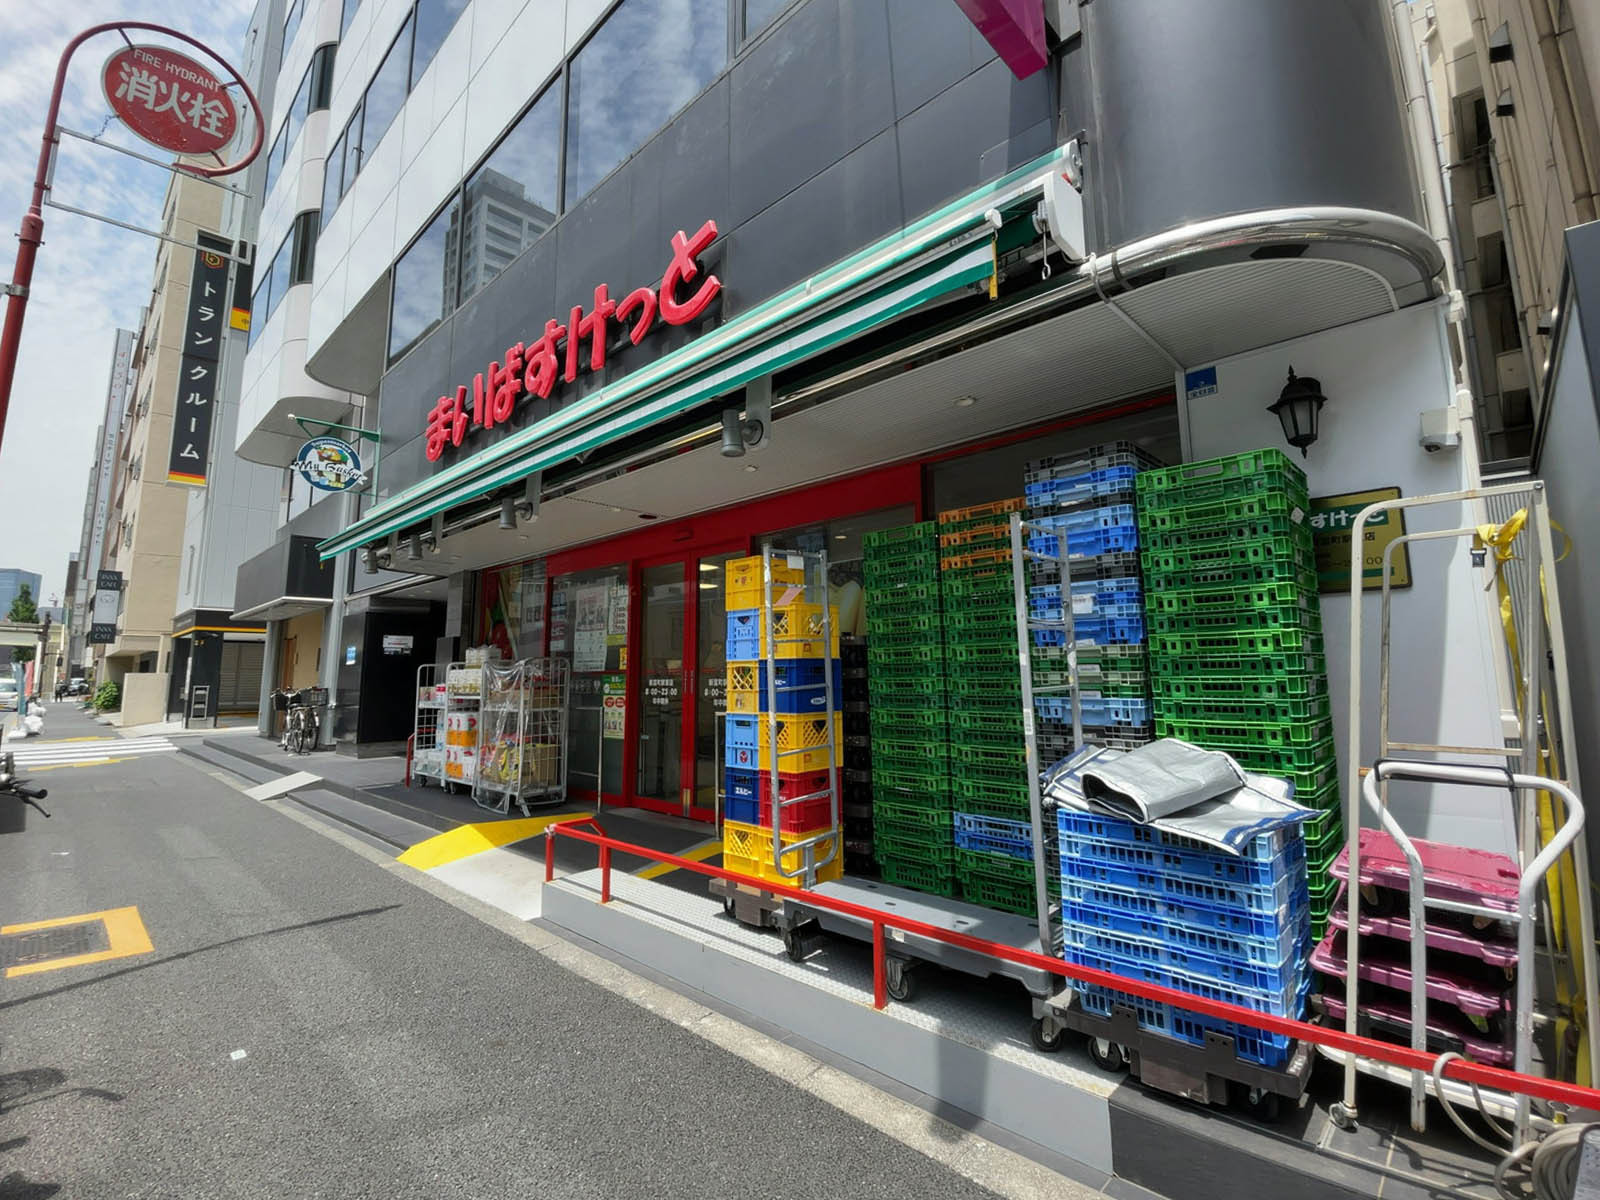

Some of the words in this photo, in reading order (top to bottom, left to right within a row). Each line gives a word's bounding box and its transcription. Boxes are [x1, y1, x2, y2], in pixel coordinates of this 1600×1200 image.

[115, 61, 229, 138] 消火栓
[134, 49, 161, 68] FIRE
[165, 62, 220, 92] HYDRANT
[179, 281, 216, 459] トランクルーム
[425, 219, 721, 462] まいばすけっと
[294, 460, 320, 473] My
